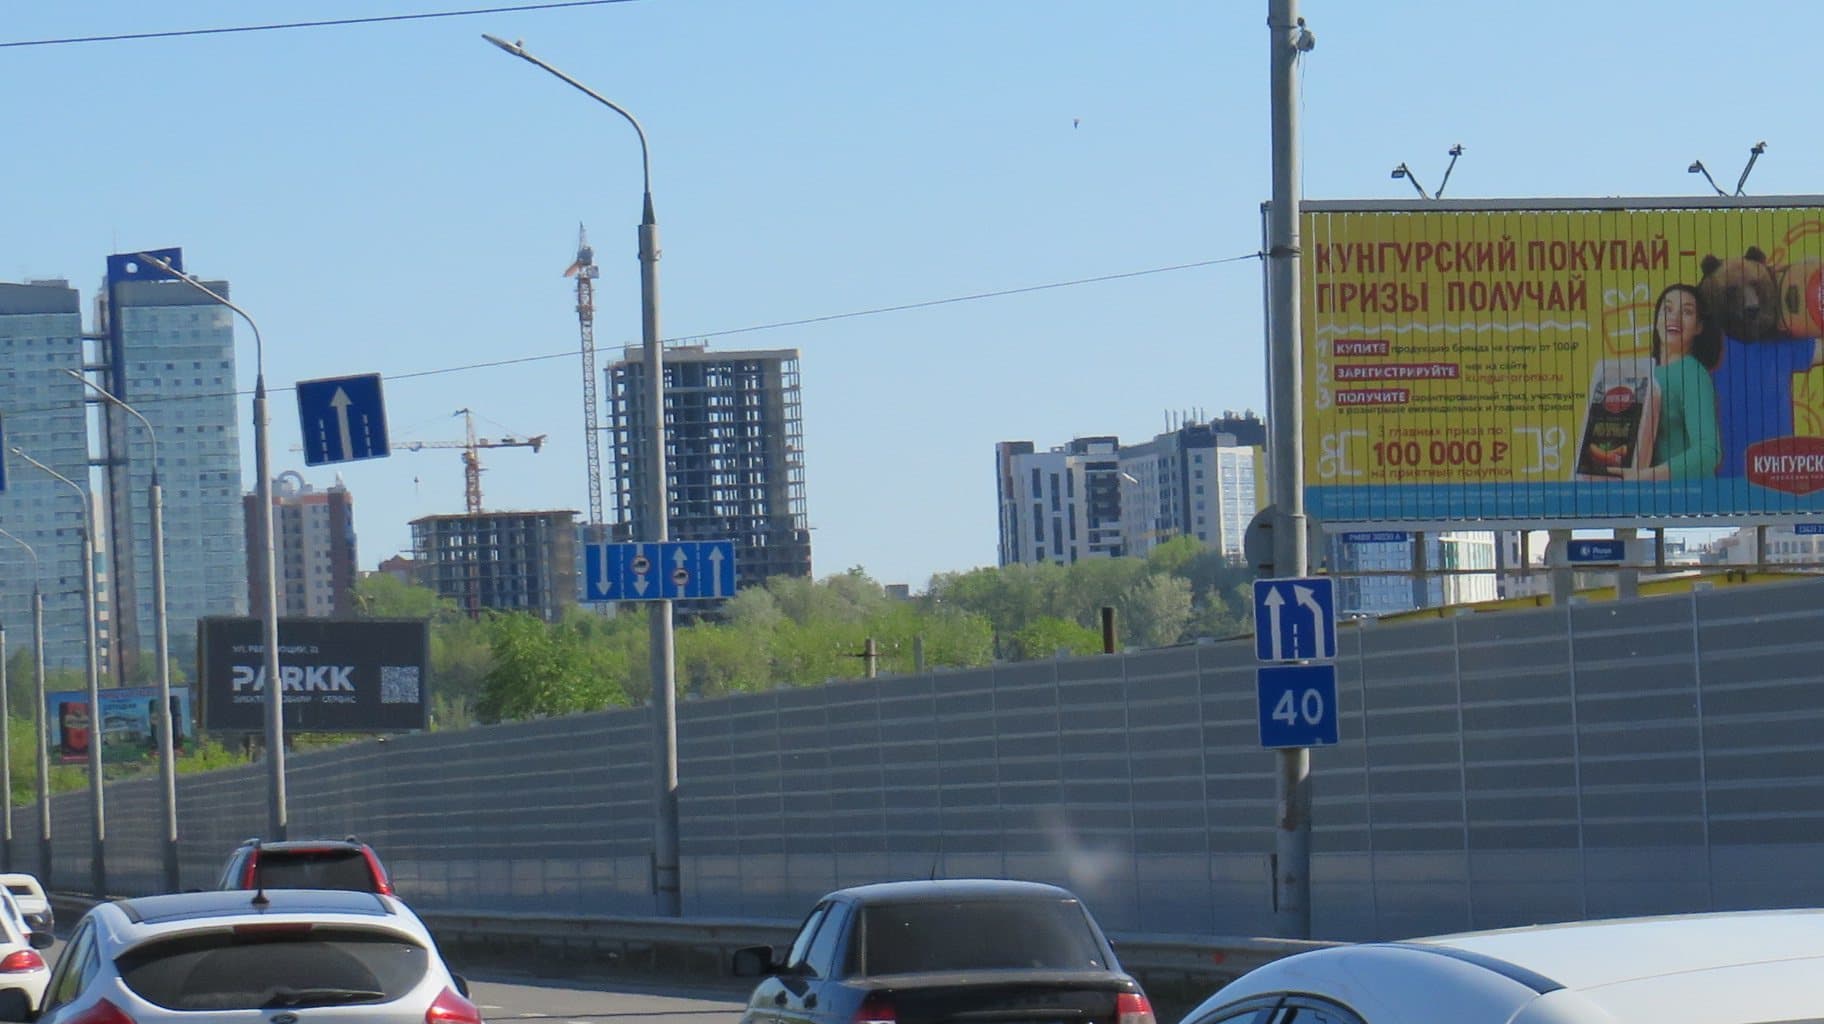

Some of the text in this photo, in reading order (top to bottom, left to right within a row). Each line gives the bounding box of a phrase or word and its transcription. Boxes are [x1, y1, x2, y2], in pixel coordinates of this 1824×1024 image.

[1316, 235, 1516, 273] КУНГУРСКИЙ
[1528, 234, 1669, 272] ПОКУПАЙ
[1317, 274, 1587, 313] ПРИЗЫ ПОЛУЧАЙ
[1336, 343, 1387, 354] КУПИТЕ
[1336, 365, 1457, 379] ЗАРЕГИСТРИРУЙТЕ
[1337, 390, 1406, 403] ПОЛУЧИТЕ
[1373, 442, 1421, 466] 100
[1430, 441, 1482, 465] 000
[1272, 688, 1324, 725] 40
